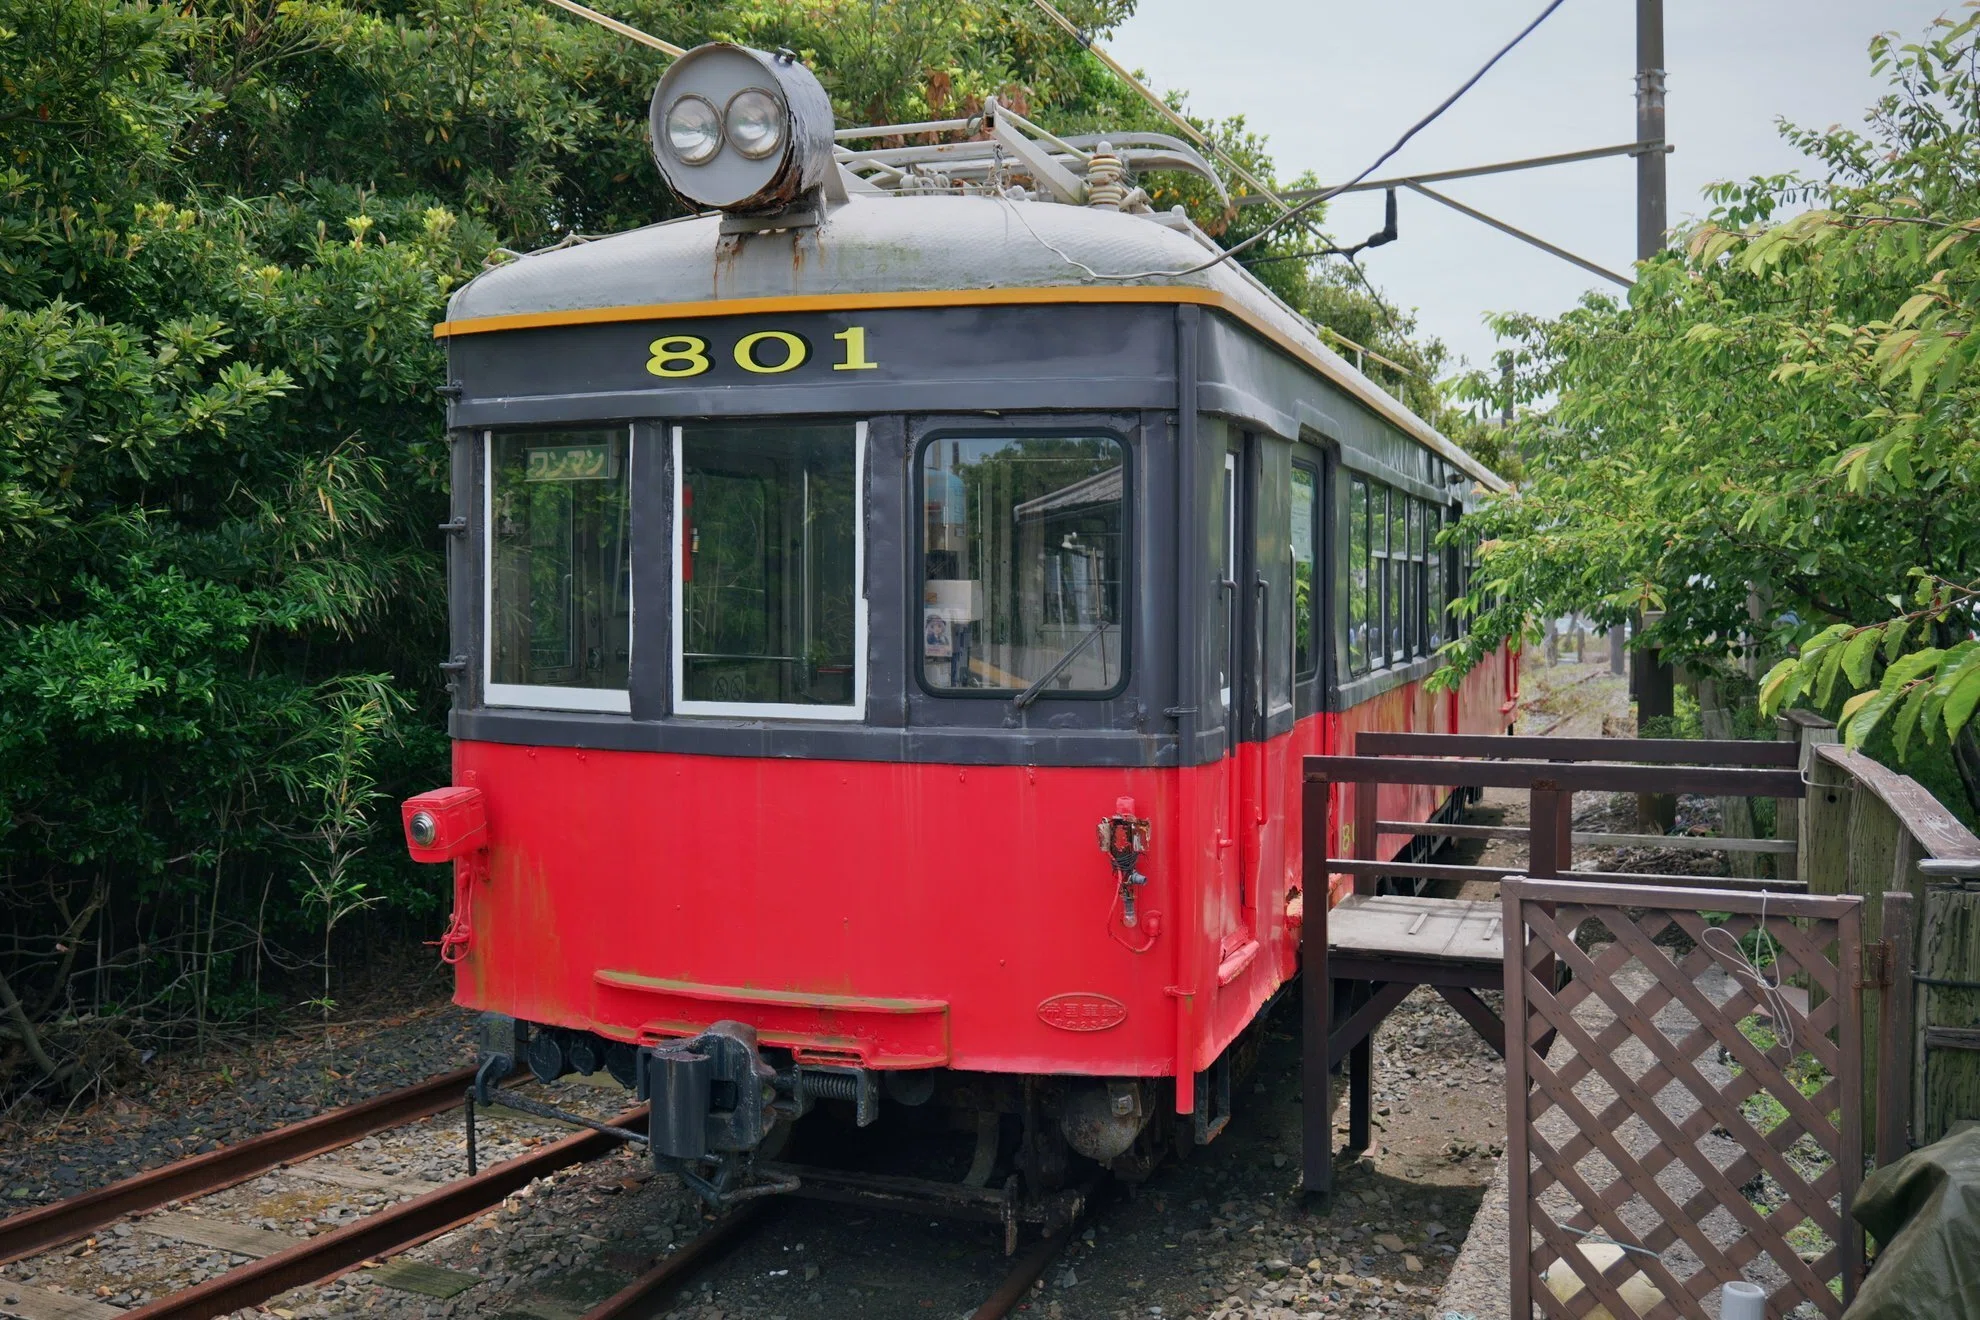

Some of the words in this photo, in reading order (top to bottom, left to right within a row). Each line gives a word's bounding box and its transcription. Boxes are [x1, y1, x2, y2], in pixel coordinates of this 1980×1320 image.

[646, 326, 878, 378] 801
[529, 449, 604, 478] ワンマン
